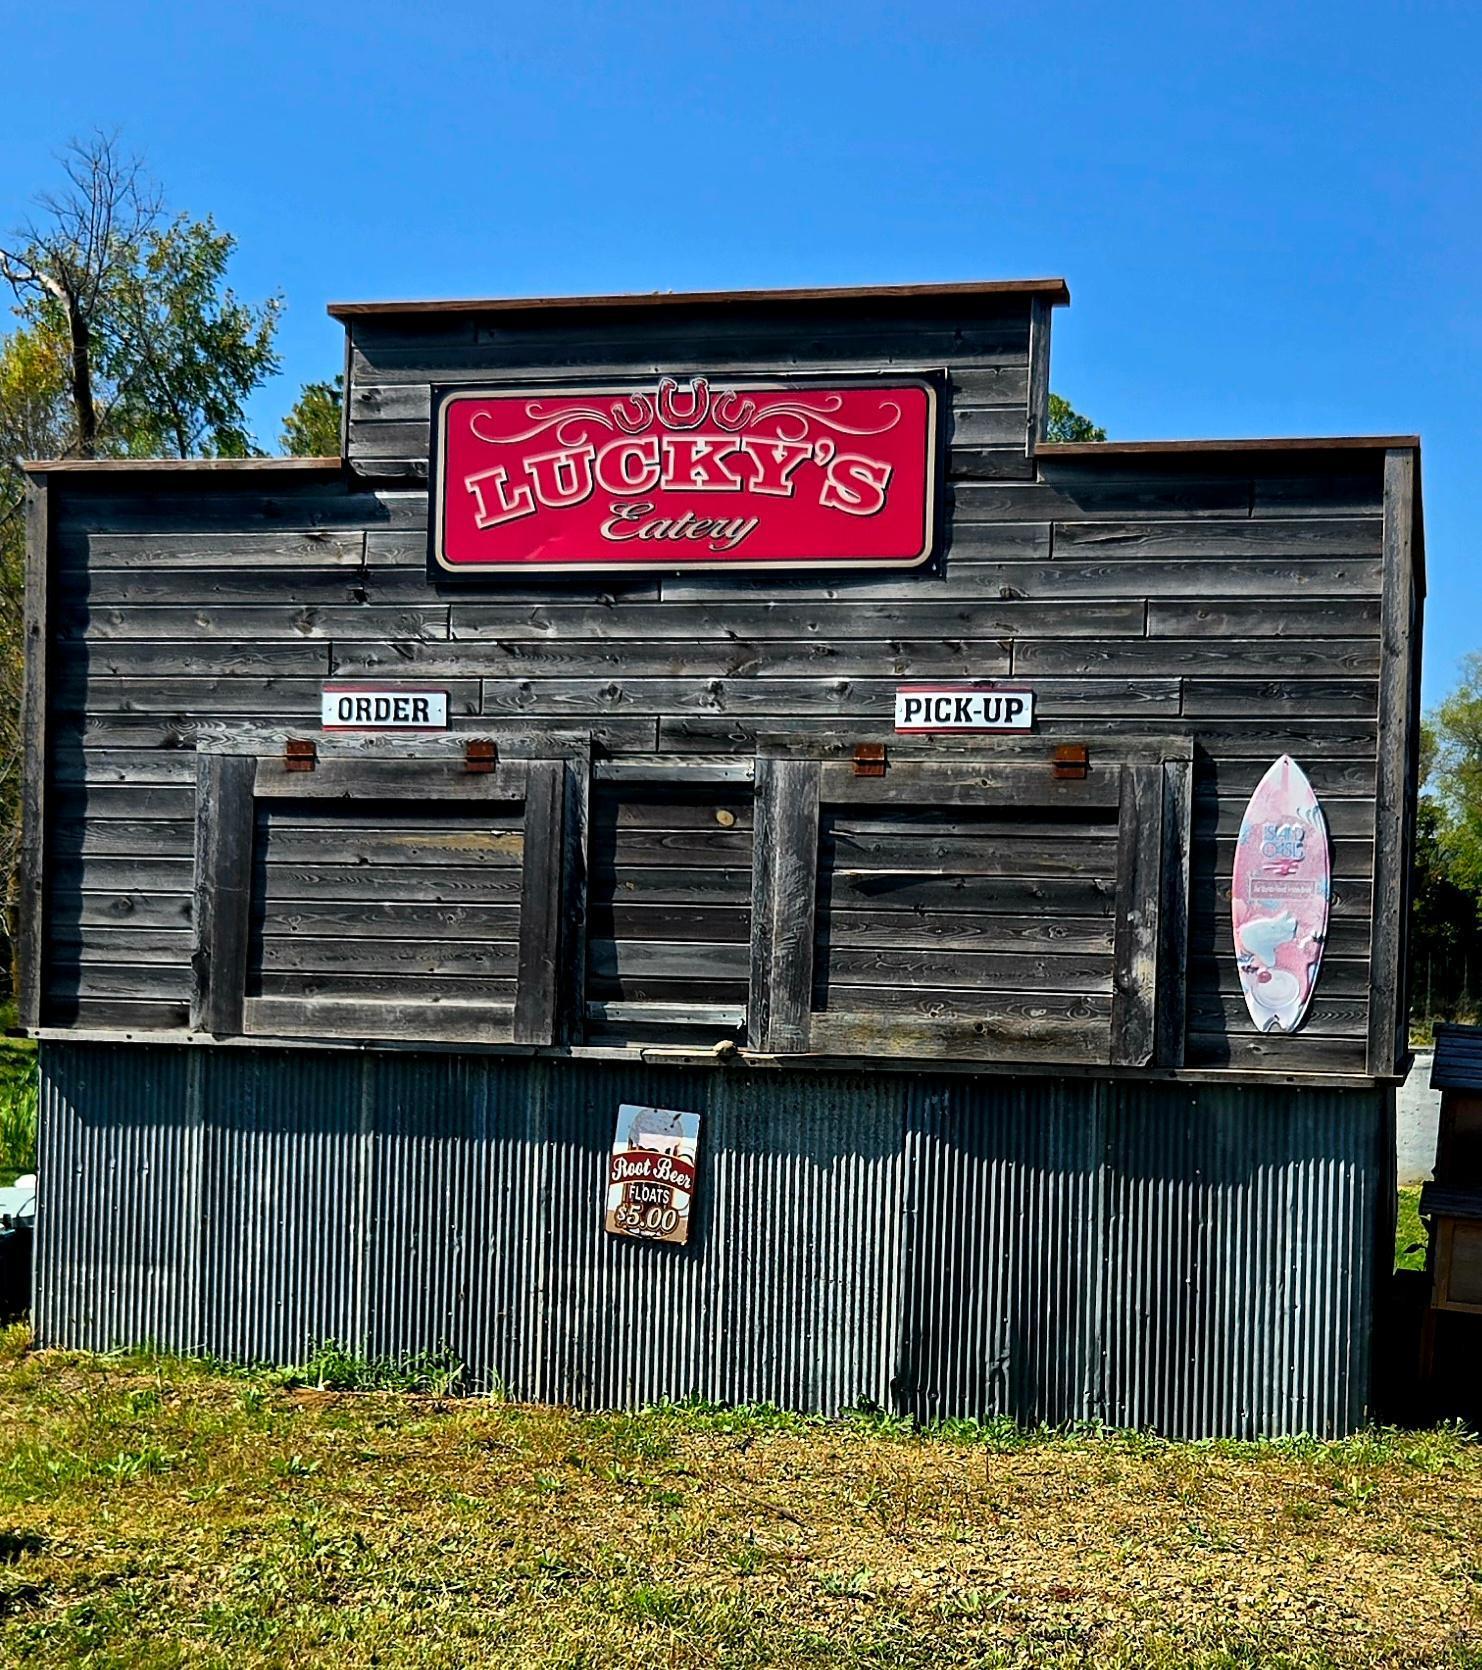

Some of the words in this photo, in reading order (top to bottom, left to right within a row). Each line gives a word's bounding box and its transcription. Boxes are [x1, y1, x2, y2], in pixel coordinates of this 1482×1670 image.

[464, 434, 892, 529] LUCKY'S
[600, 502, 759, 551] Eatery
[338, 697, 429, 722] ORDER
[904, 697, 1024, 723] PICK-UP
[612, 1157, 651, 1180] Root
[653, 1157, 691, 1189] Beer
[629, 1185, 670, 1204] FLOATS
[616, 1204, 678, 1231] $5.00
